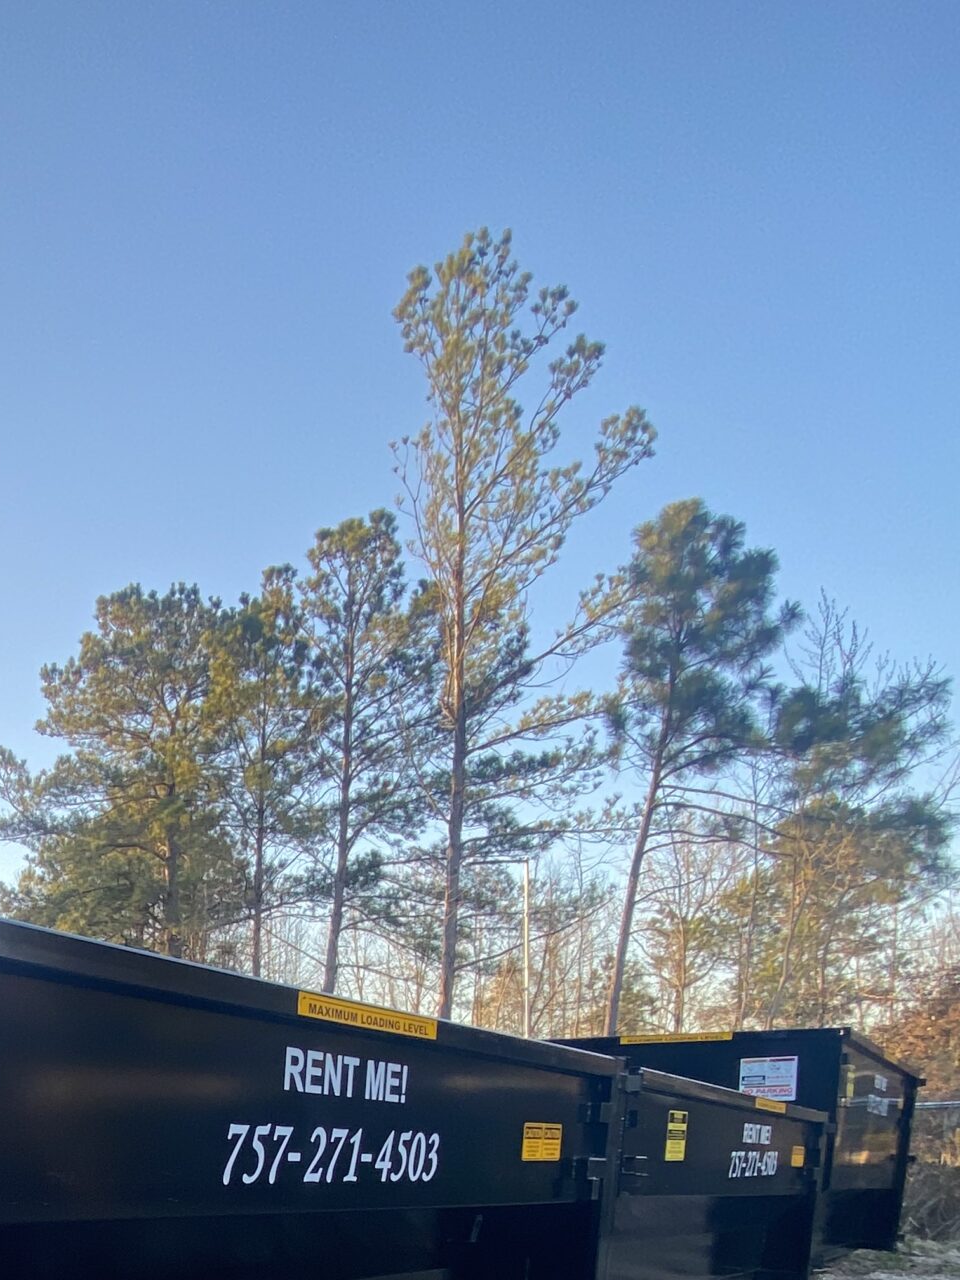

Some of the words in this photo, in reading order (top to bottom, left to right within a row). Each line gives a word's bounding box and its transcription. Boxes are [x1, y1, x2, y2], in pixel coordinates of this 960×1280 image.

[308, 1003, 358, 1023] MAXIMUM
[361, 1014, 401, 1031] LOADING
[403, 1022, 429, 1036] LEVEL
[283, 1046, 361, 1098] RENT
[364, 1059, 409, 1104] ME!
[222, 1122, 440, 1185] 757-271-4503
[742, 1123, 760, 1144] RENT
